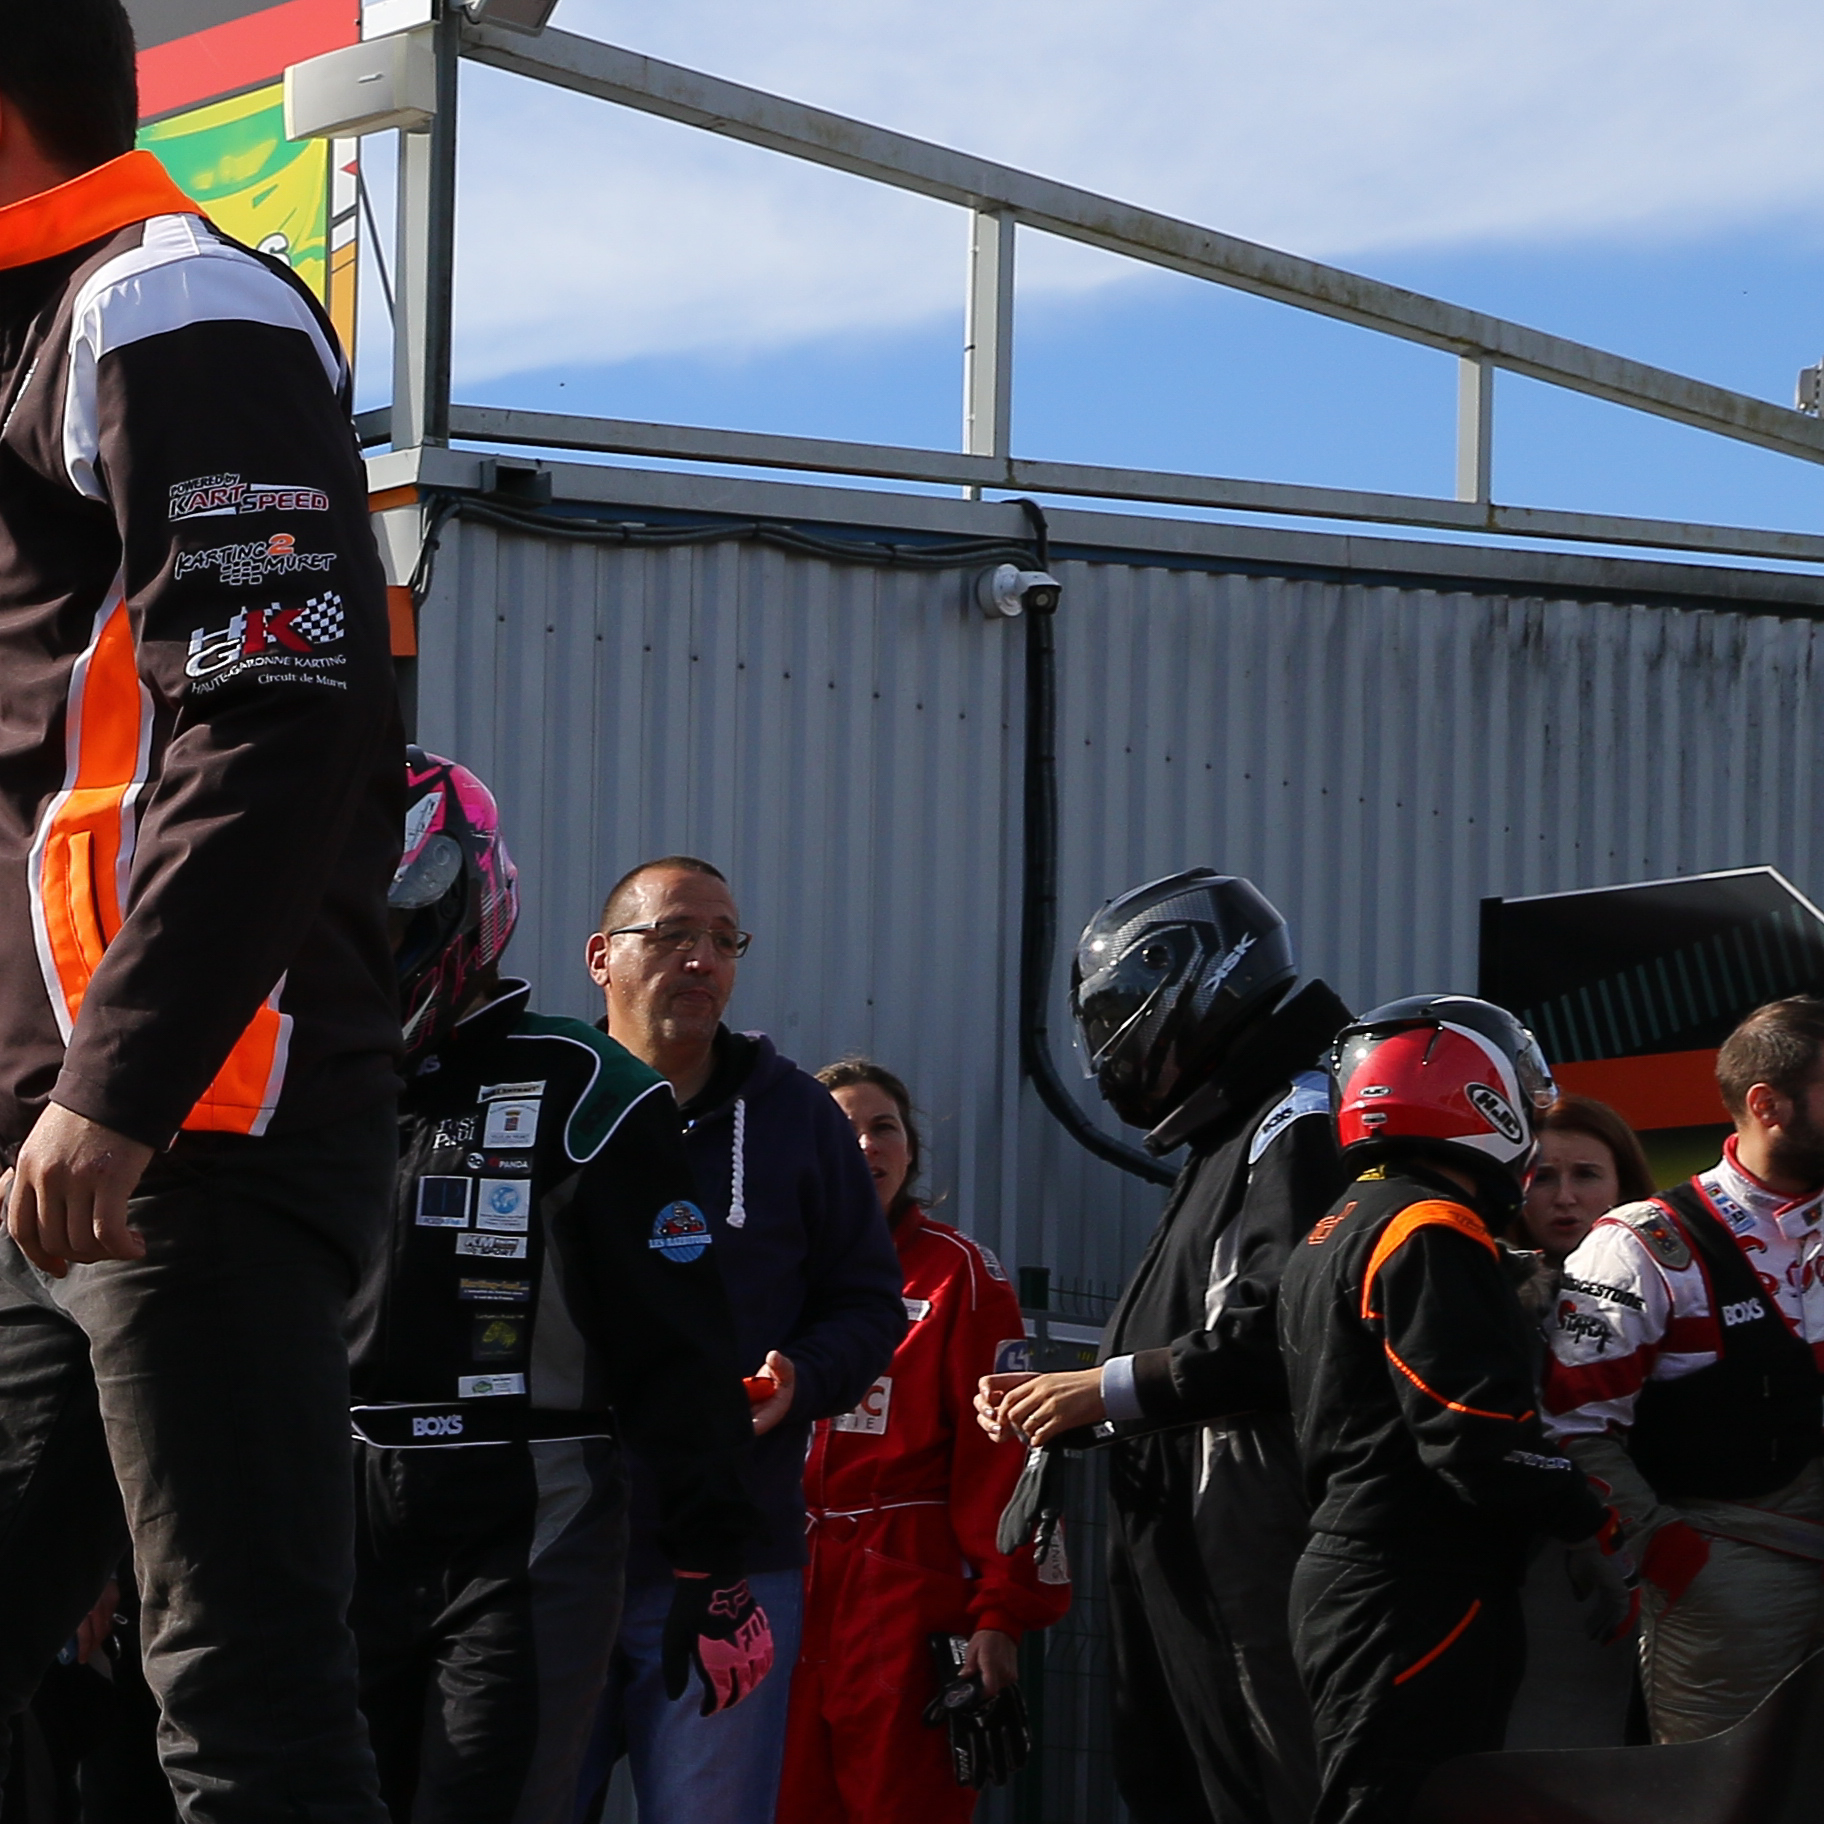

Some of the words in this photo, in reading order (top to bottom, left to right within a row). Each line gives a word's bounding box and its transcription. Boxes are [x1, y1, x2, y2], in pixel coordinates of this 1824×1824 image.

[170, 475, 223, 498] POWERED
[223, 472, 240, 486] by
[267, 532, 296, 556] 2
[174, 541, 267, 580] KARTING
[263, 553, 337, 575] MURET
[191, 656, 292, 694] HAUTE-GARONNE
[293, 654, 347, 669] KARTING
[257, 672, 297, 685] Circuit
[300, 672, 314, 684] de
[316, 676, 348, 691] Muret
[1474, 1090, 1521, 1136] HJC
